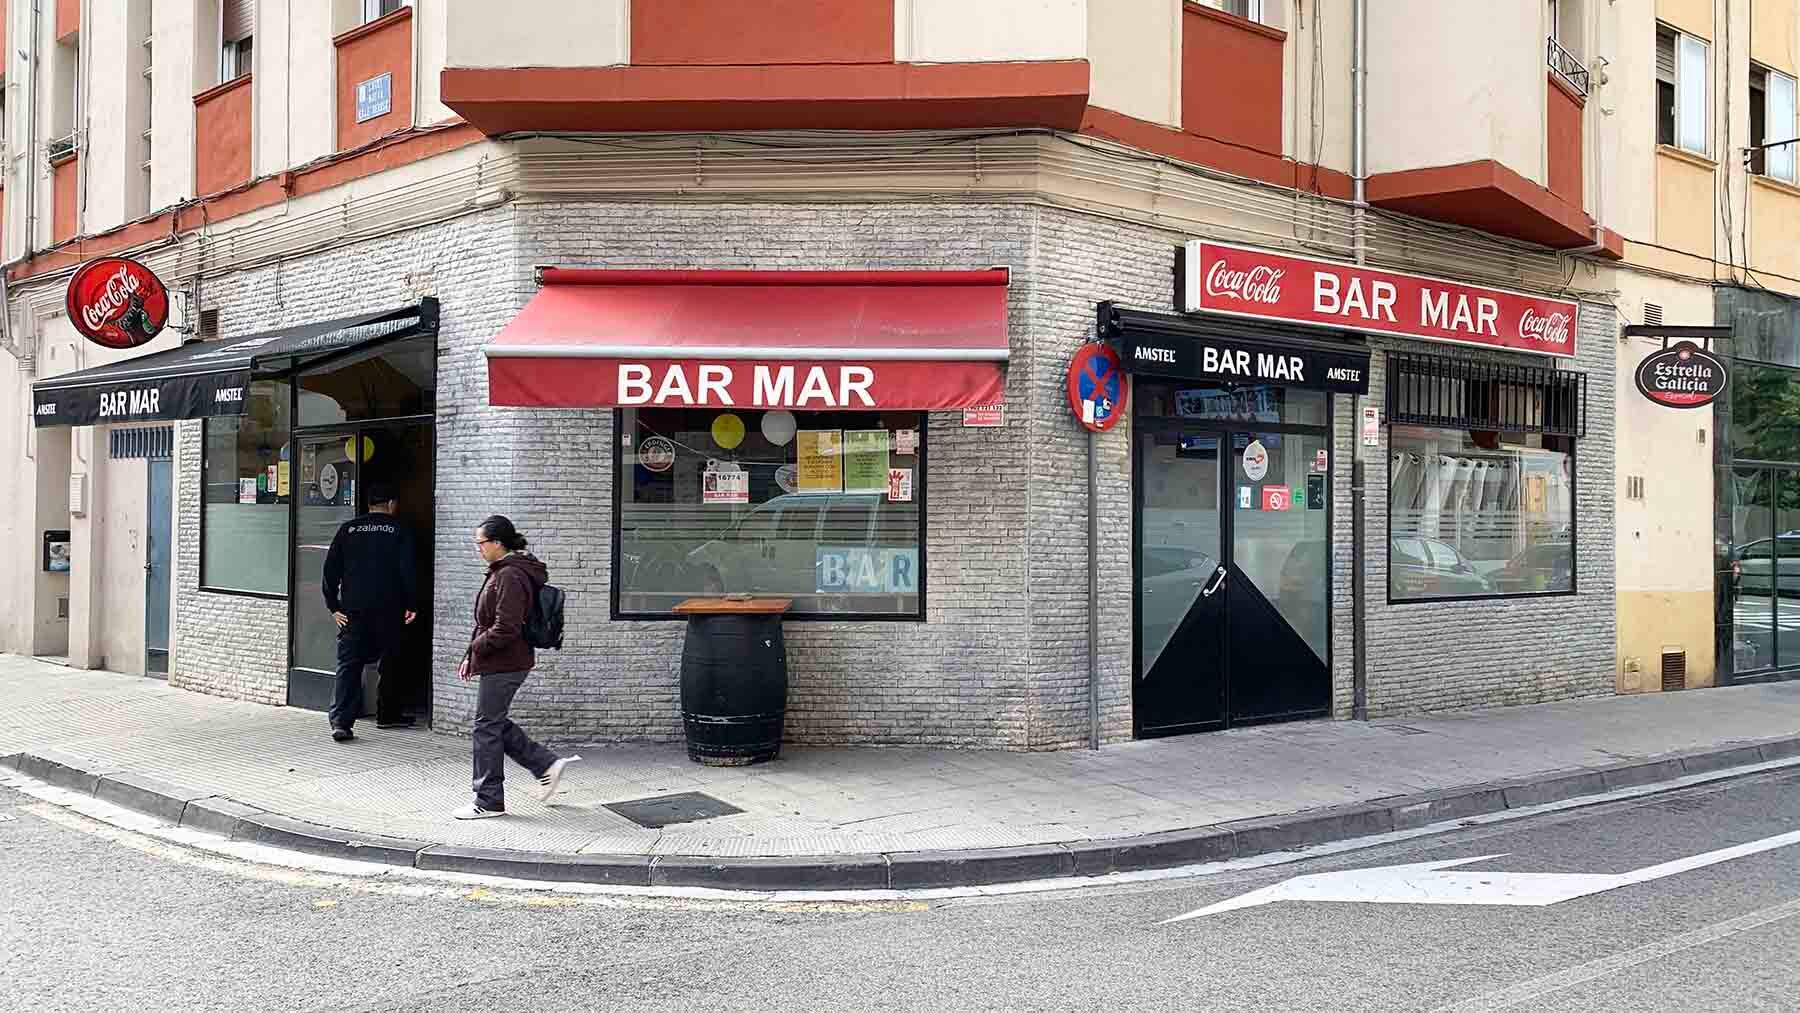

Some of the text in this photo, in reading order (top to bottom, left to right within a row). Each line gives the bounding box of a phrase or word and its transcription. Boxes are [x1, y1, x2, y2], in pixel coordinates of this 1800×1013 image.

[82, 264, 140, 331] Coca-Cola
[1206, 260, 1573, 344] Coca-Cola BAR MAR Coca-Cola
[1134, 346, 1360, 382] AMSTEL BAR MAR AMSTEL
[1654, 361, 1712, 377] Estrella
[100, 392, 127, 416] BAR
[129, 389, 160, 414] MAR
[215, 387, 243, 402] AMSTEL
[617, 363, 876, 406] BAR MAR
[1655, 376, 1708, 391] Galicia
[356, 523, 395, 533] zalando
[822, 551, 912, 587] BAR
